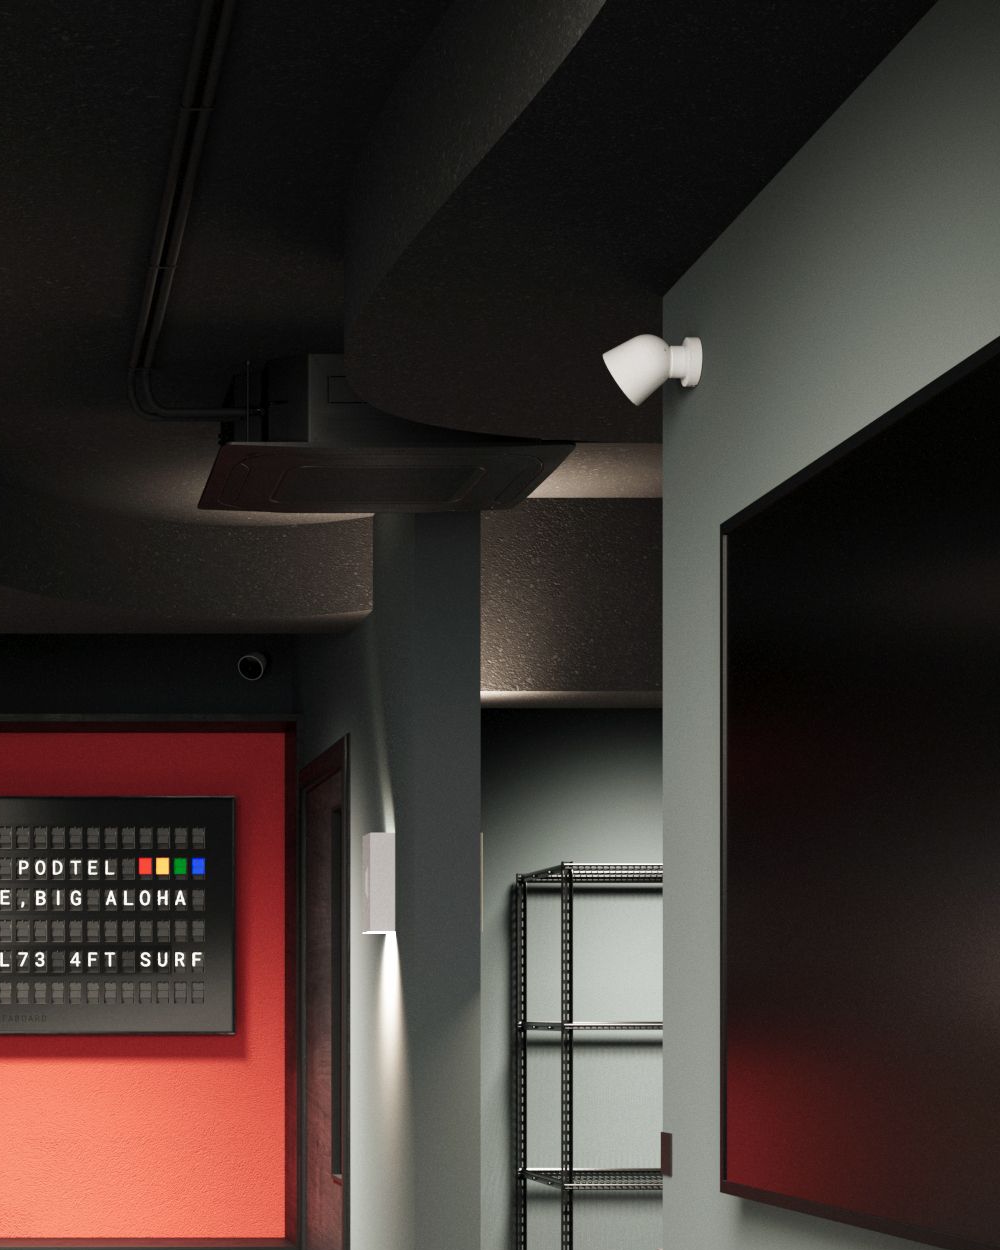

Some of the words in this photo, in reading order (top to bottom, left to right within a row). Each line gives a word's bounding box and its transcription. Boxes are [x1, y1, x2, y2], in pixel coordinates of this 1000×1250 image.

[18, 858, 117, 876] PODTEL
[105, 889, 188, 906] ALOHA
[0, 951, 47, 968] L73
[69, 951, 117, 968] 4FT
[140, 951, 204, 968] SURF
